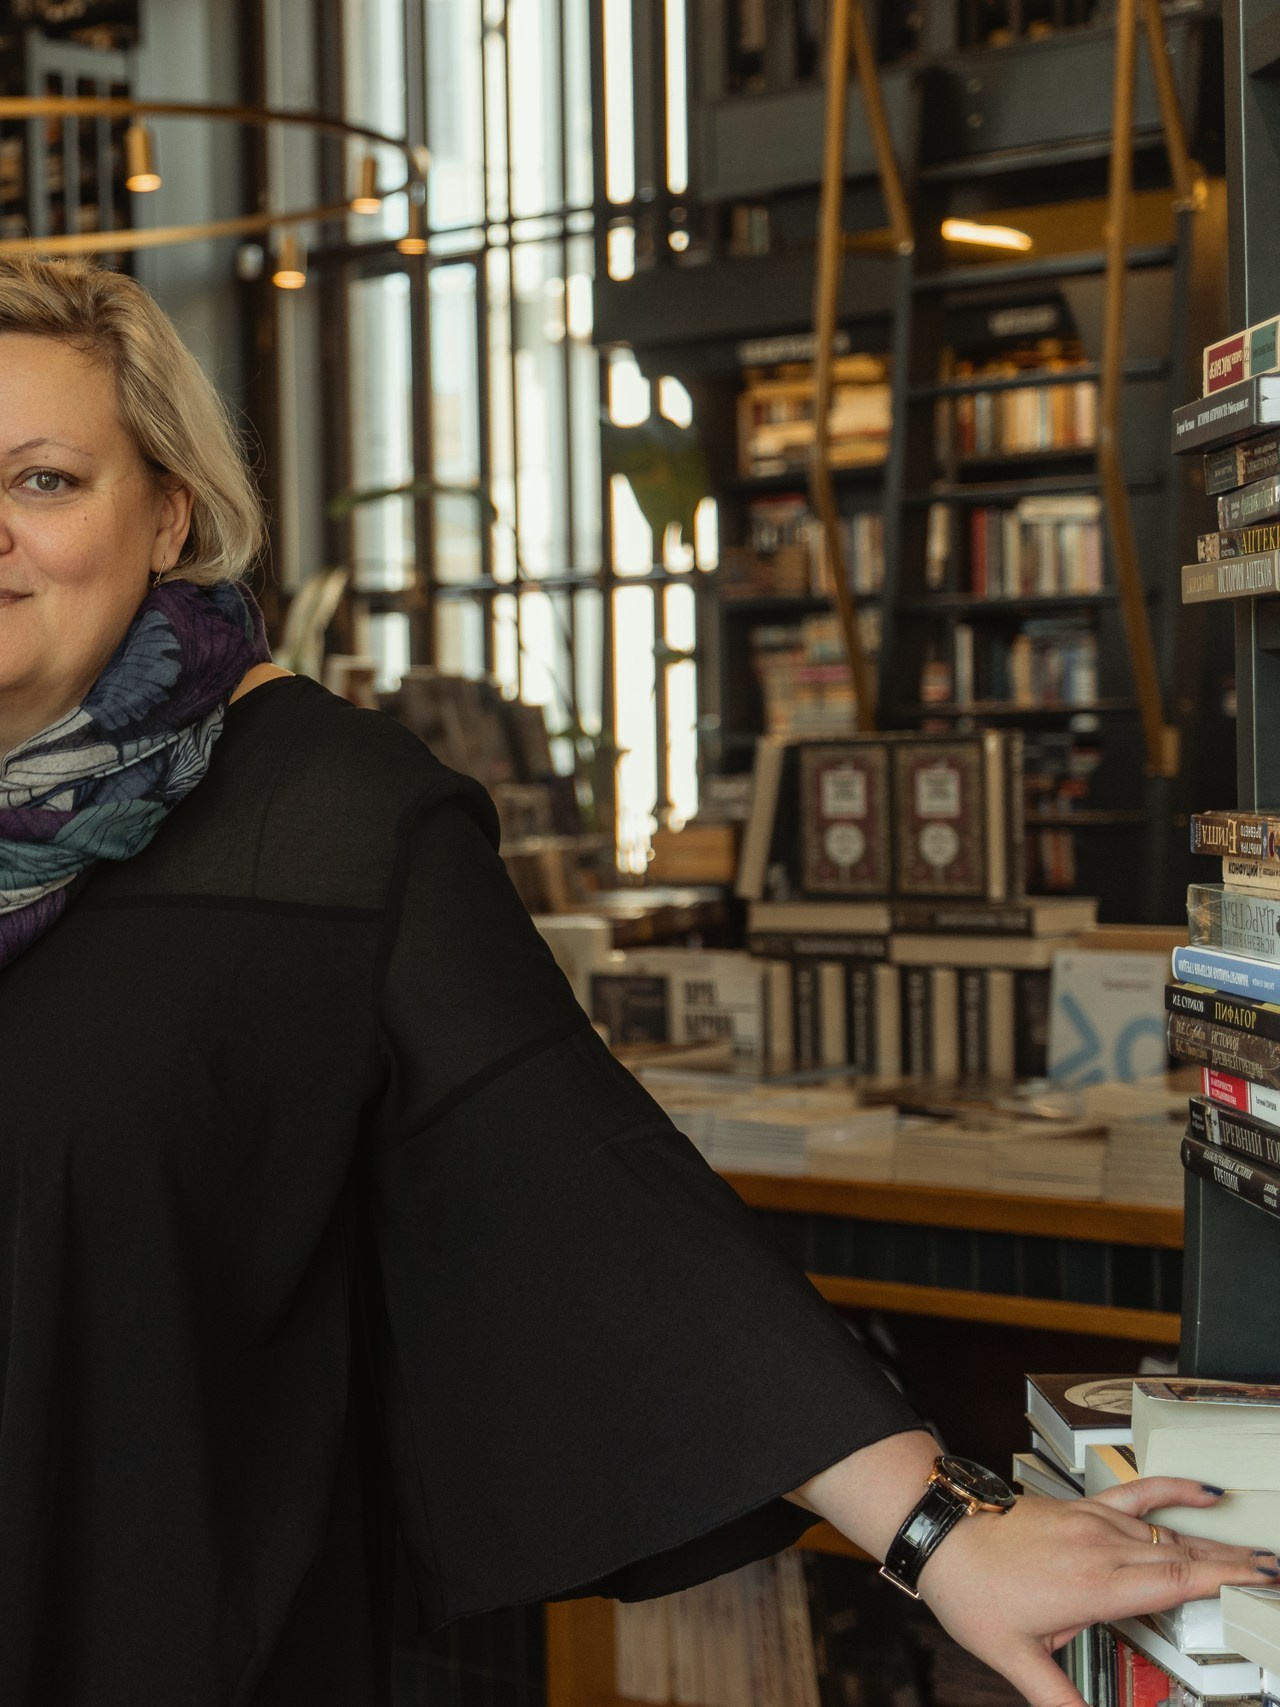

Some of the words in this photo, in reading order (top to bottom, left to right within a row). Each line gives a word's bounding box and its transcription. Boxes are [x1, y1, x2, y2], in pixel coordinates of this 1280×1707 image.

[1217, 563, 1245, 593] ИСТОРИЯ
[1246, 558, 1272, 591] АЦТЕКОВ
[1240, 842, 1262, 856] КУЛЬТУРА
[1228, 861, 1258, 878] КОНФУЦИЙ
[1222, 900, 1275, 936] ЦАРСТВА
[1223, 929, 1275, 955] ИСЧЕЗНУВШИЕ
[1181, 996, 1204, 1013] СУРИКОВ
[1215, 1002, 1257, 1030] ПИФАГОР
[1220, 1120, 1263, 1157] ДРЕВНИЙ
[1213, 1166, 1240, 1192] ГРЕЦИИ
